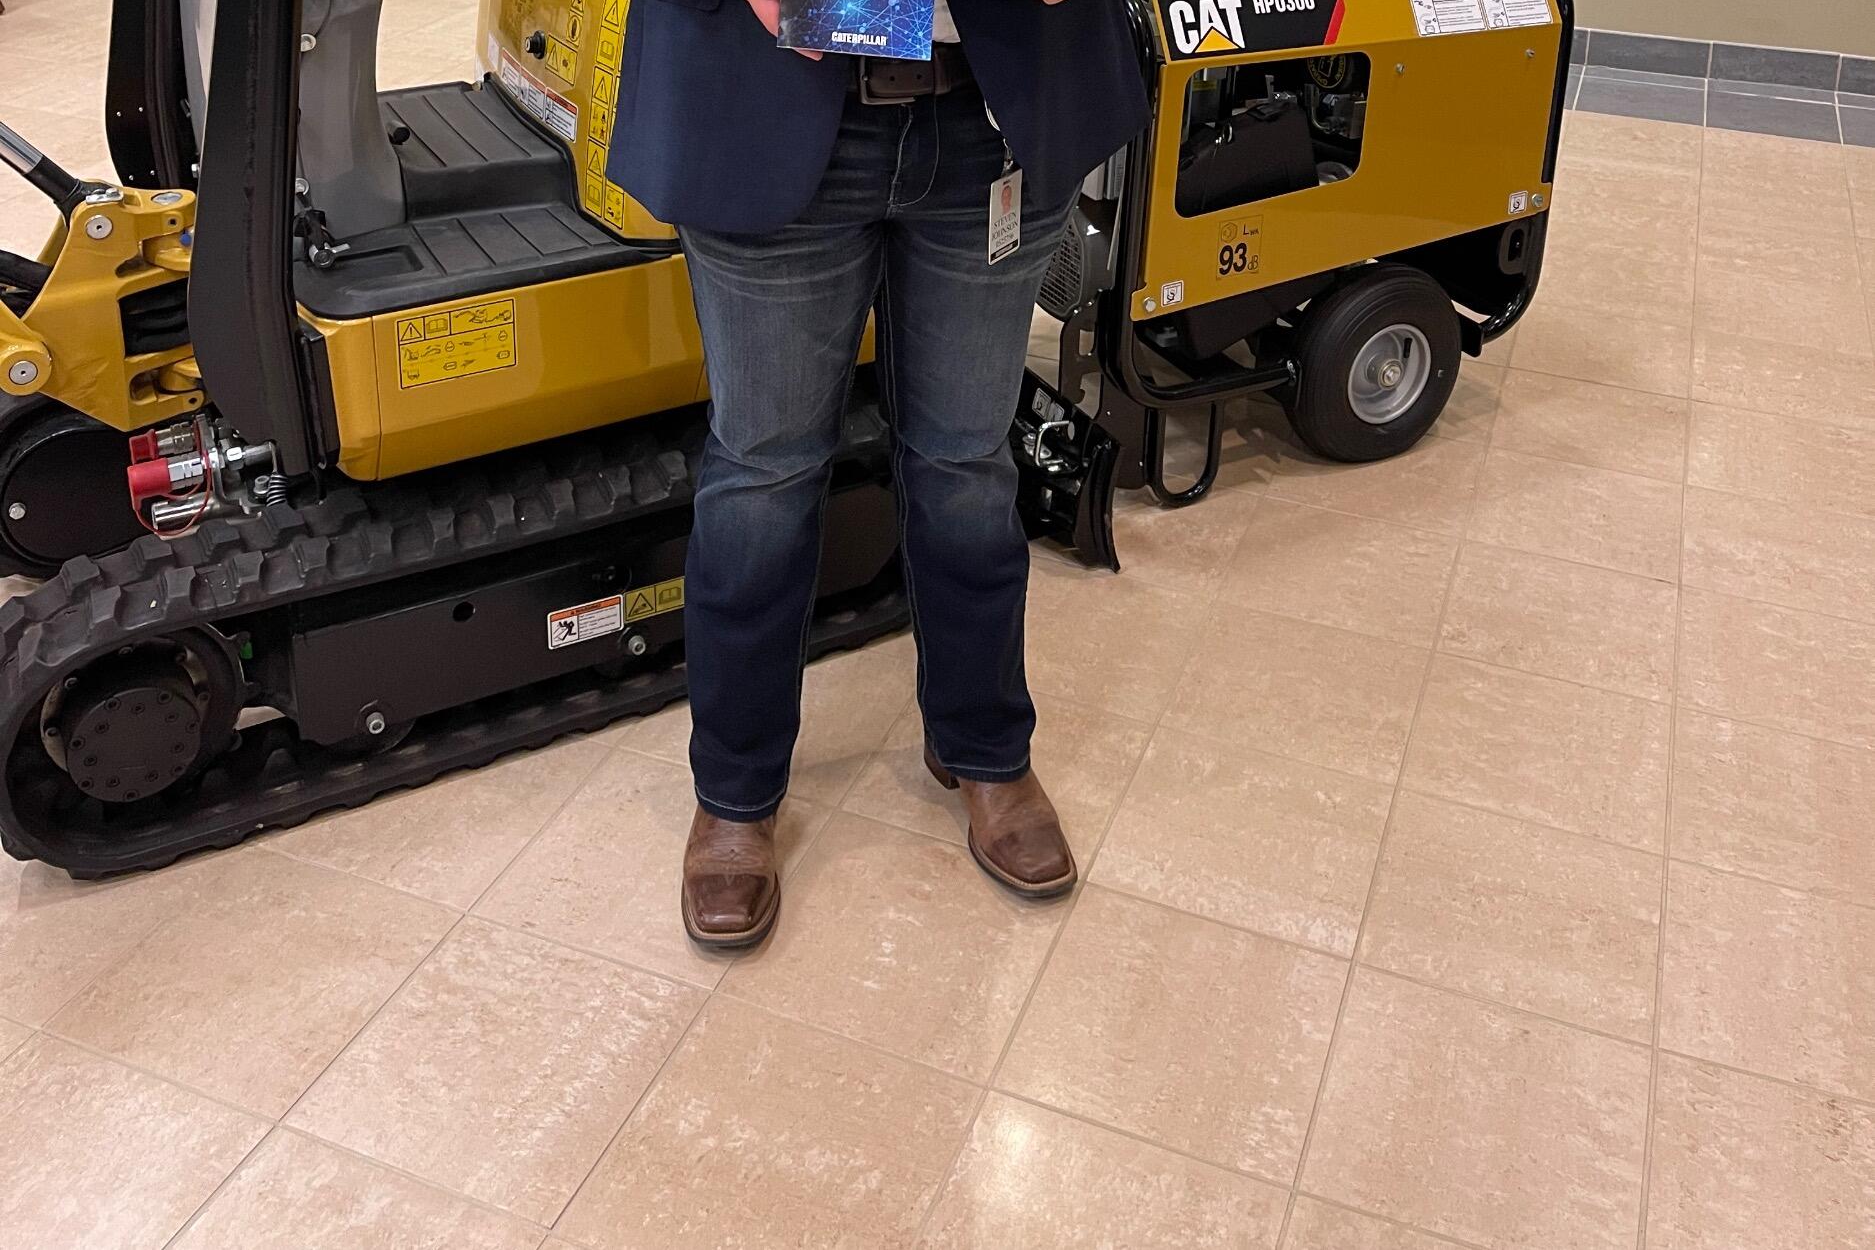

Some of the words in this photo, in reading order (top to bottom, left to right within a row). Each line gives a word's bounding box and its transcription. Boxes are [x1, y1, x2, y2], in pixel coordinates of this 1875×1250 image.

[831, 31, 887, 46] CATERPILLAR
[1219, 243, 1247, 275] 93
[1247, 255, 1259, 271] dB
